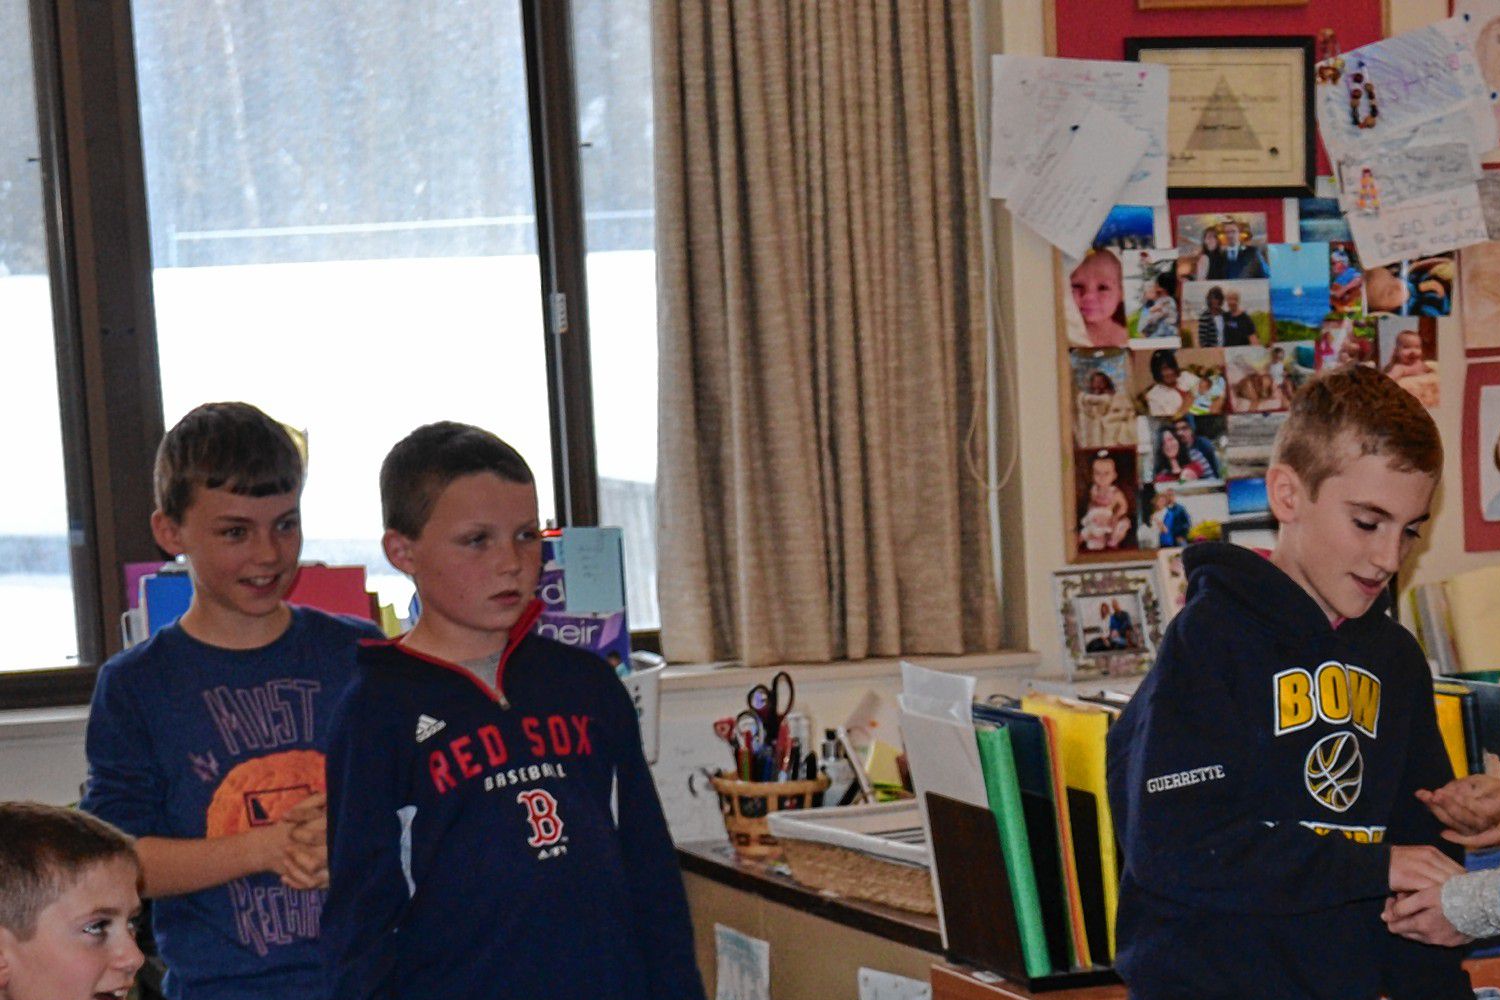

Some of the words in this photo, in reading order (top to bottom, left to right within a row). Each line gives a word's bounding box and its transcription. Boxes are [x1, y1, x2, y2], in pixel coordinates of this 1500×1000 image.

[203, 679, 321, 756] MUST
[1273, 661, 1382, 739] BOW
[429, 724, 509, 794] RED
[521, 714, 592, 757] SOX
[1147, 765, 1225, 793] GUERRETTE
[516, 788, 564, 848] B
